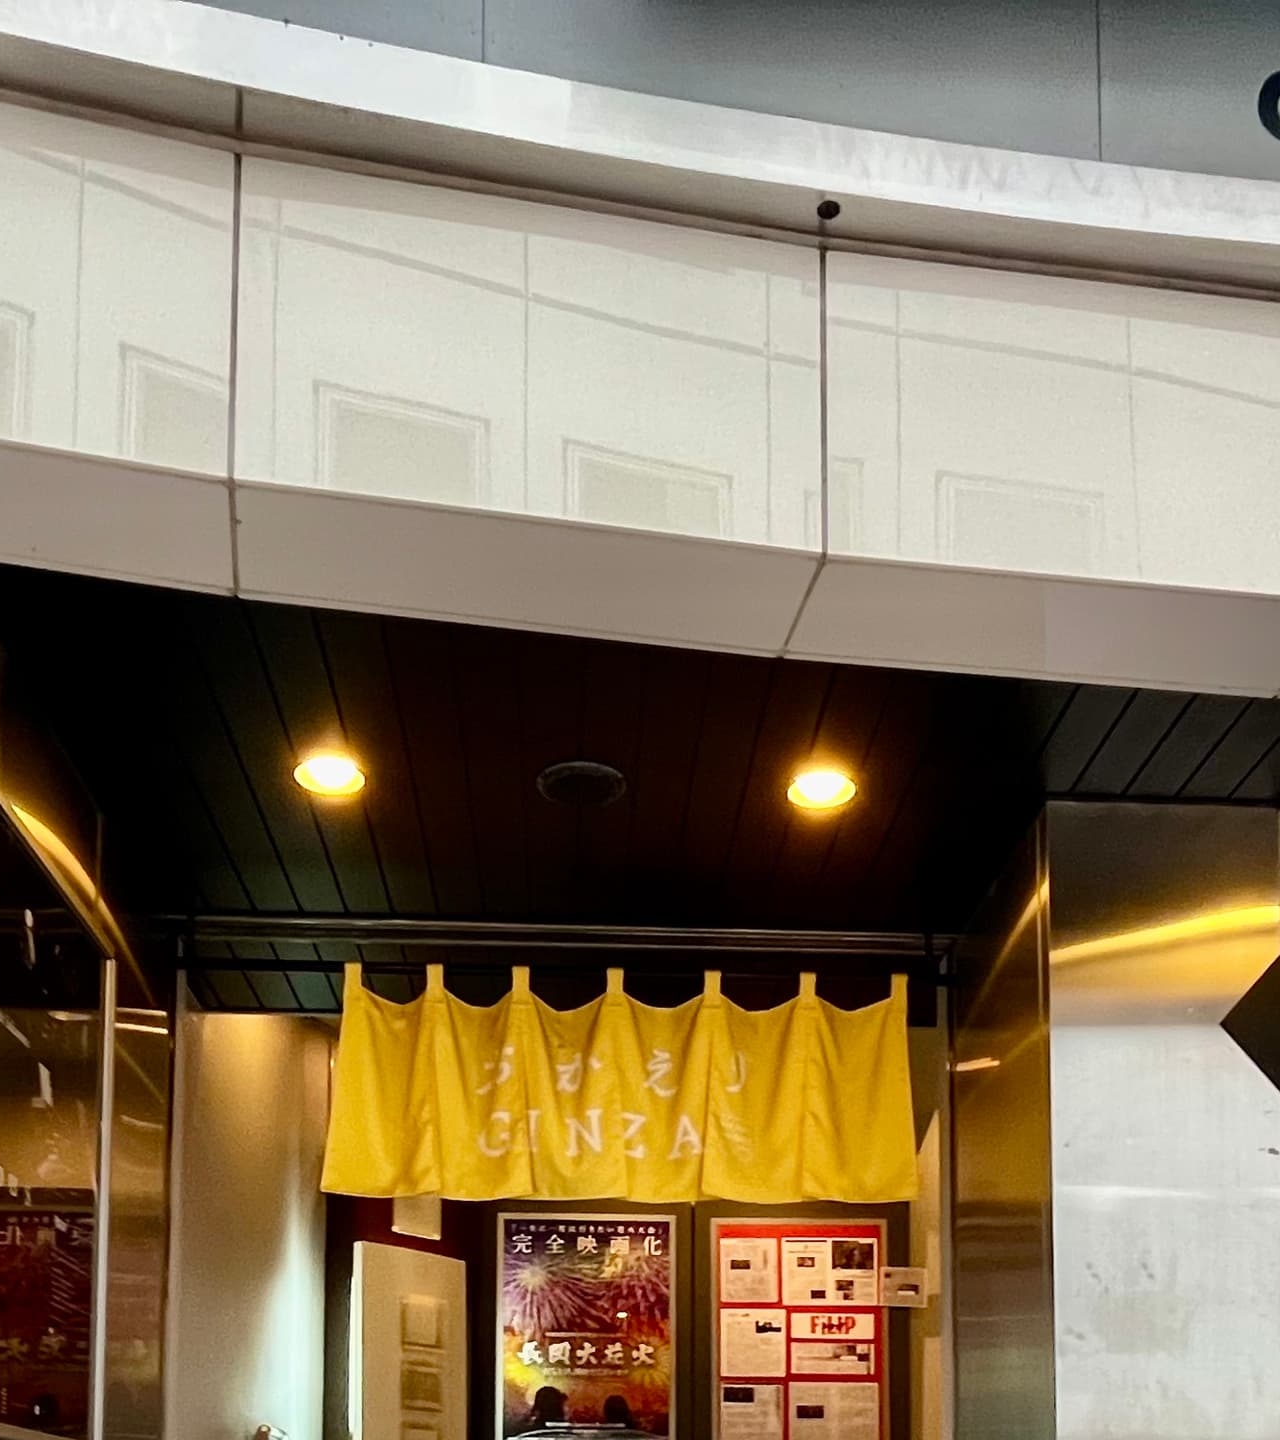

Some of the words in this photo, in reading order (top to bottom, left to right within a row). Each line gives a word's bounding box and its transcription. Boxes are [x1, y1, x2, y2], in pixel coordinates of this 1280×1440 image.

[478, 1108, 703, 1159] GINZA
[511, 1233, 663, 1256] 完全映画化
